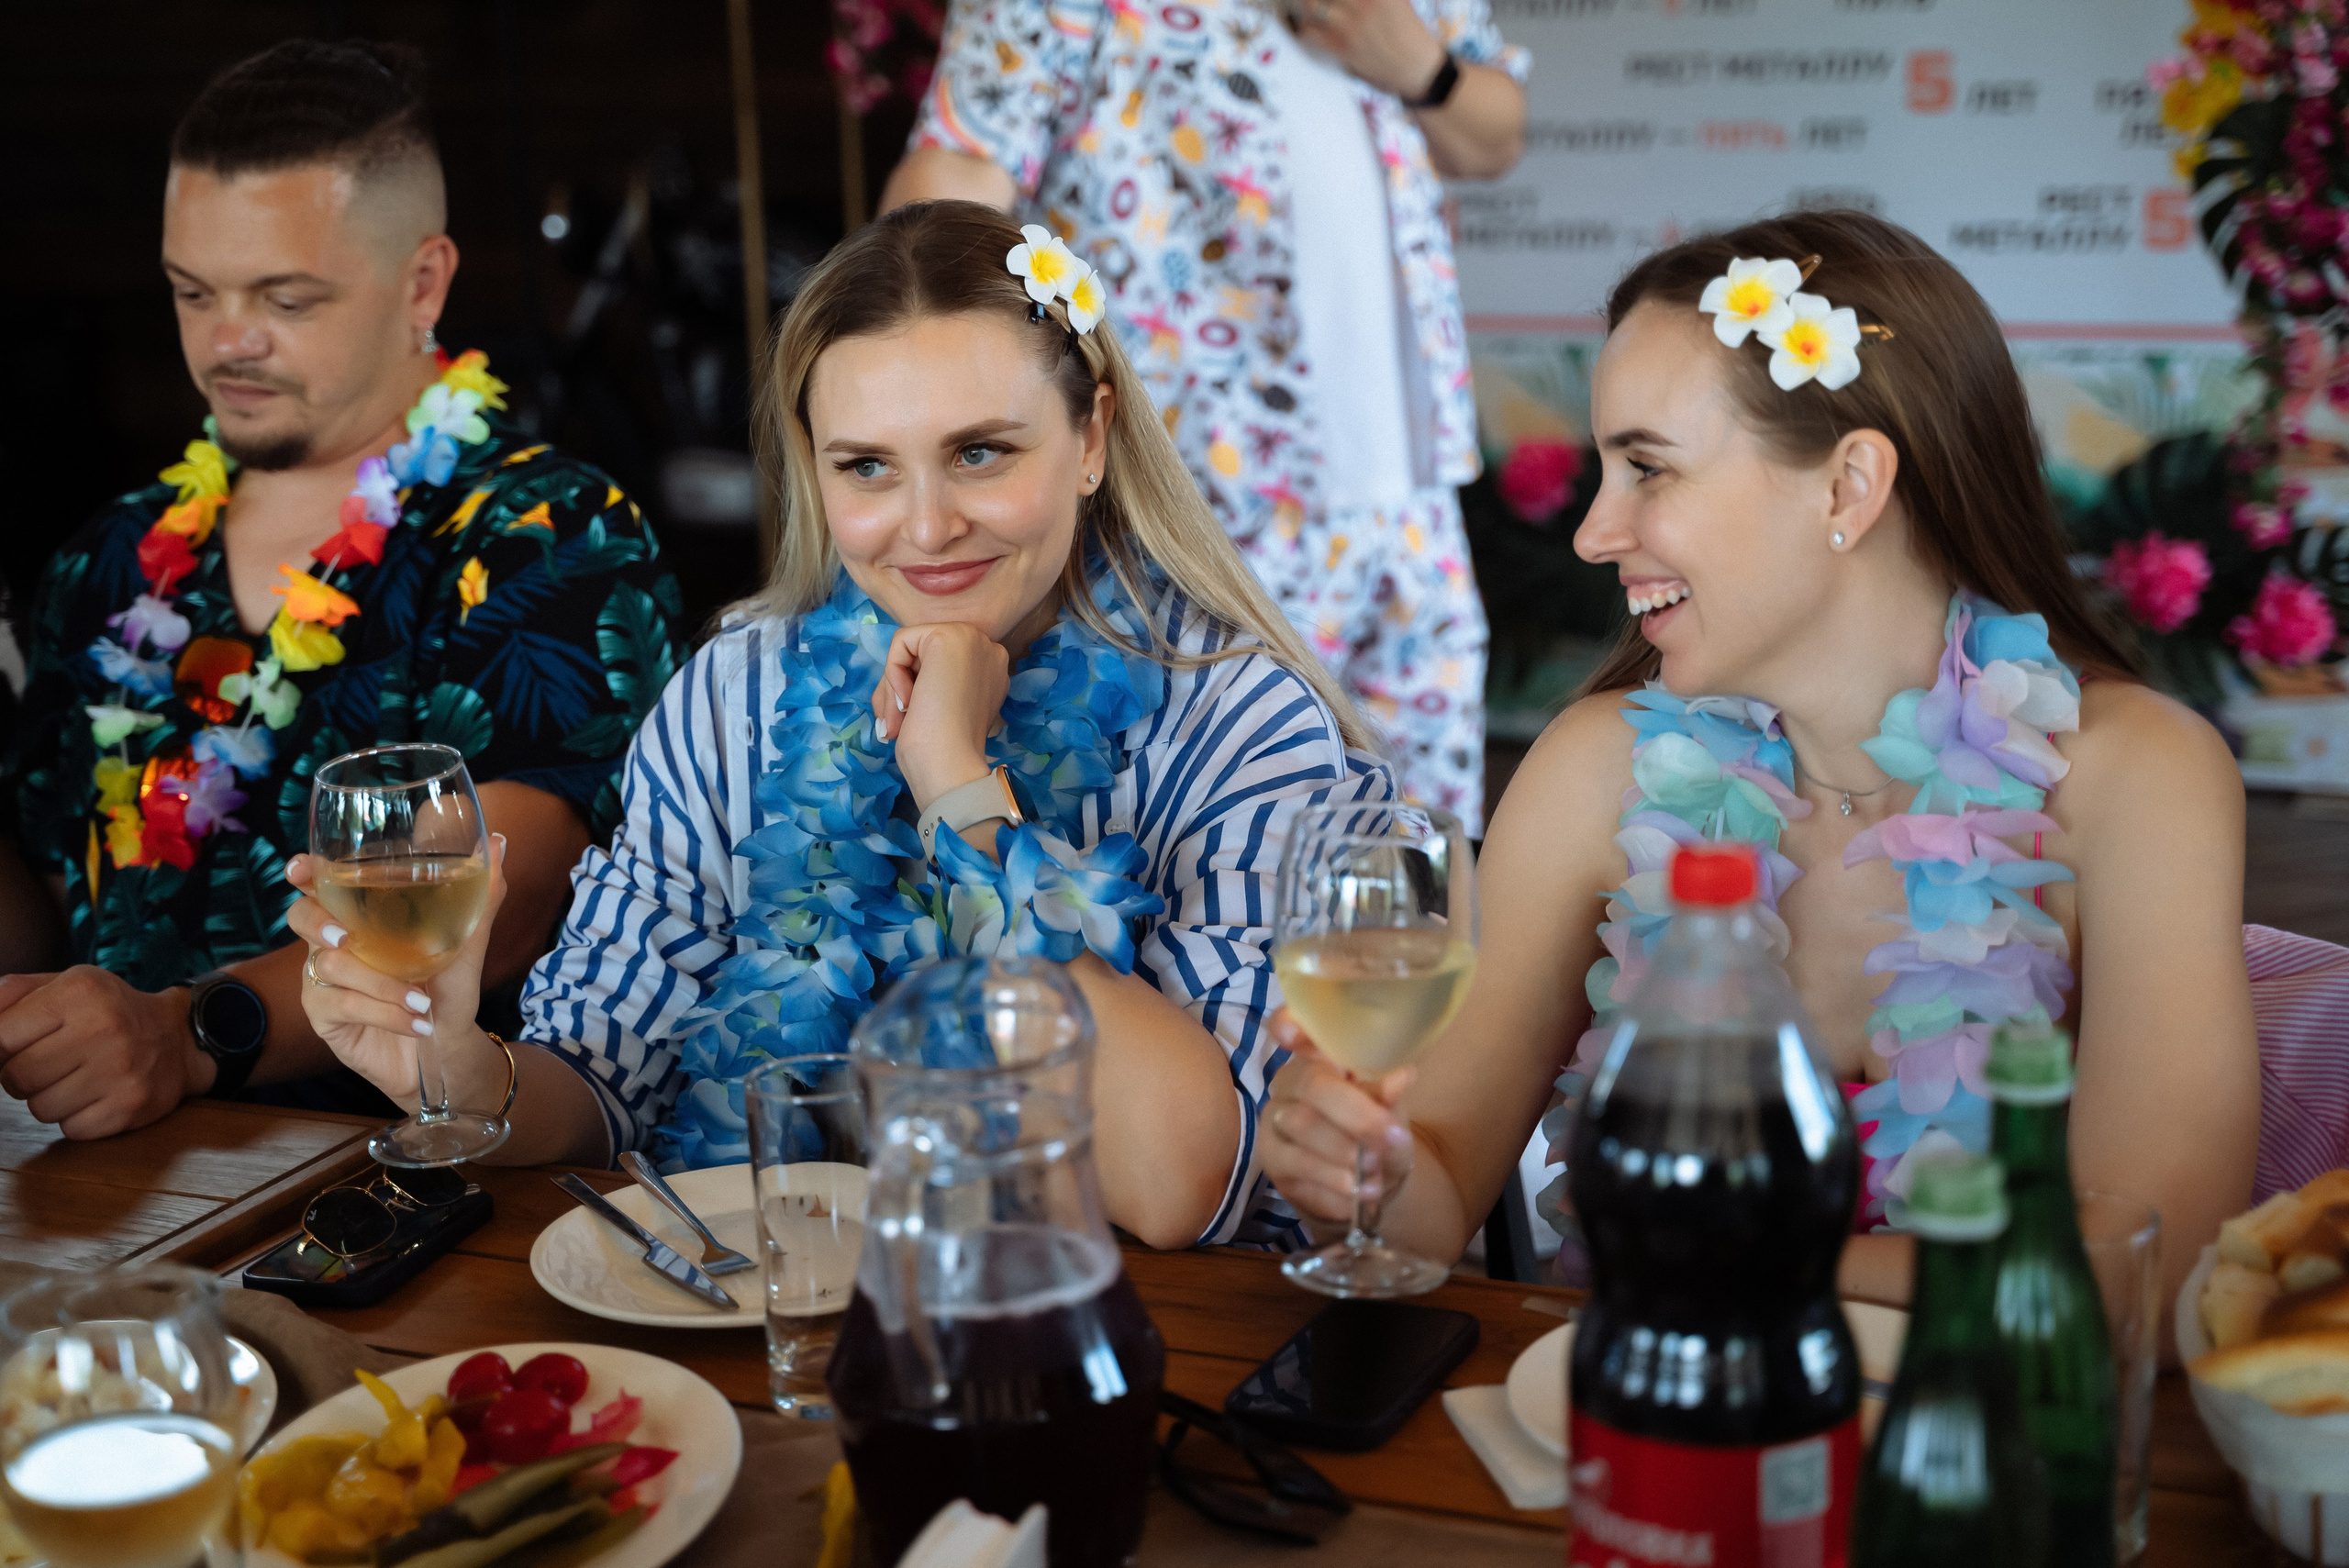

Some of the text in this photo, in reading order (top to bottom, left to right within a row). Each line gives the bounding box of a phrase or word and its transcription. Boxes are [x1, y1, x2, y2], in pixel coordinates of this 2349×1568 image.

[1907, 50, 1954, 113] 5
[1965, 81, 2036, 114] ЛЕТ
[1802, 118, 1866, 150] ЛЕТ
[2143, 189, 2193, 250] 5
